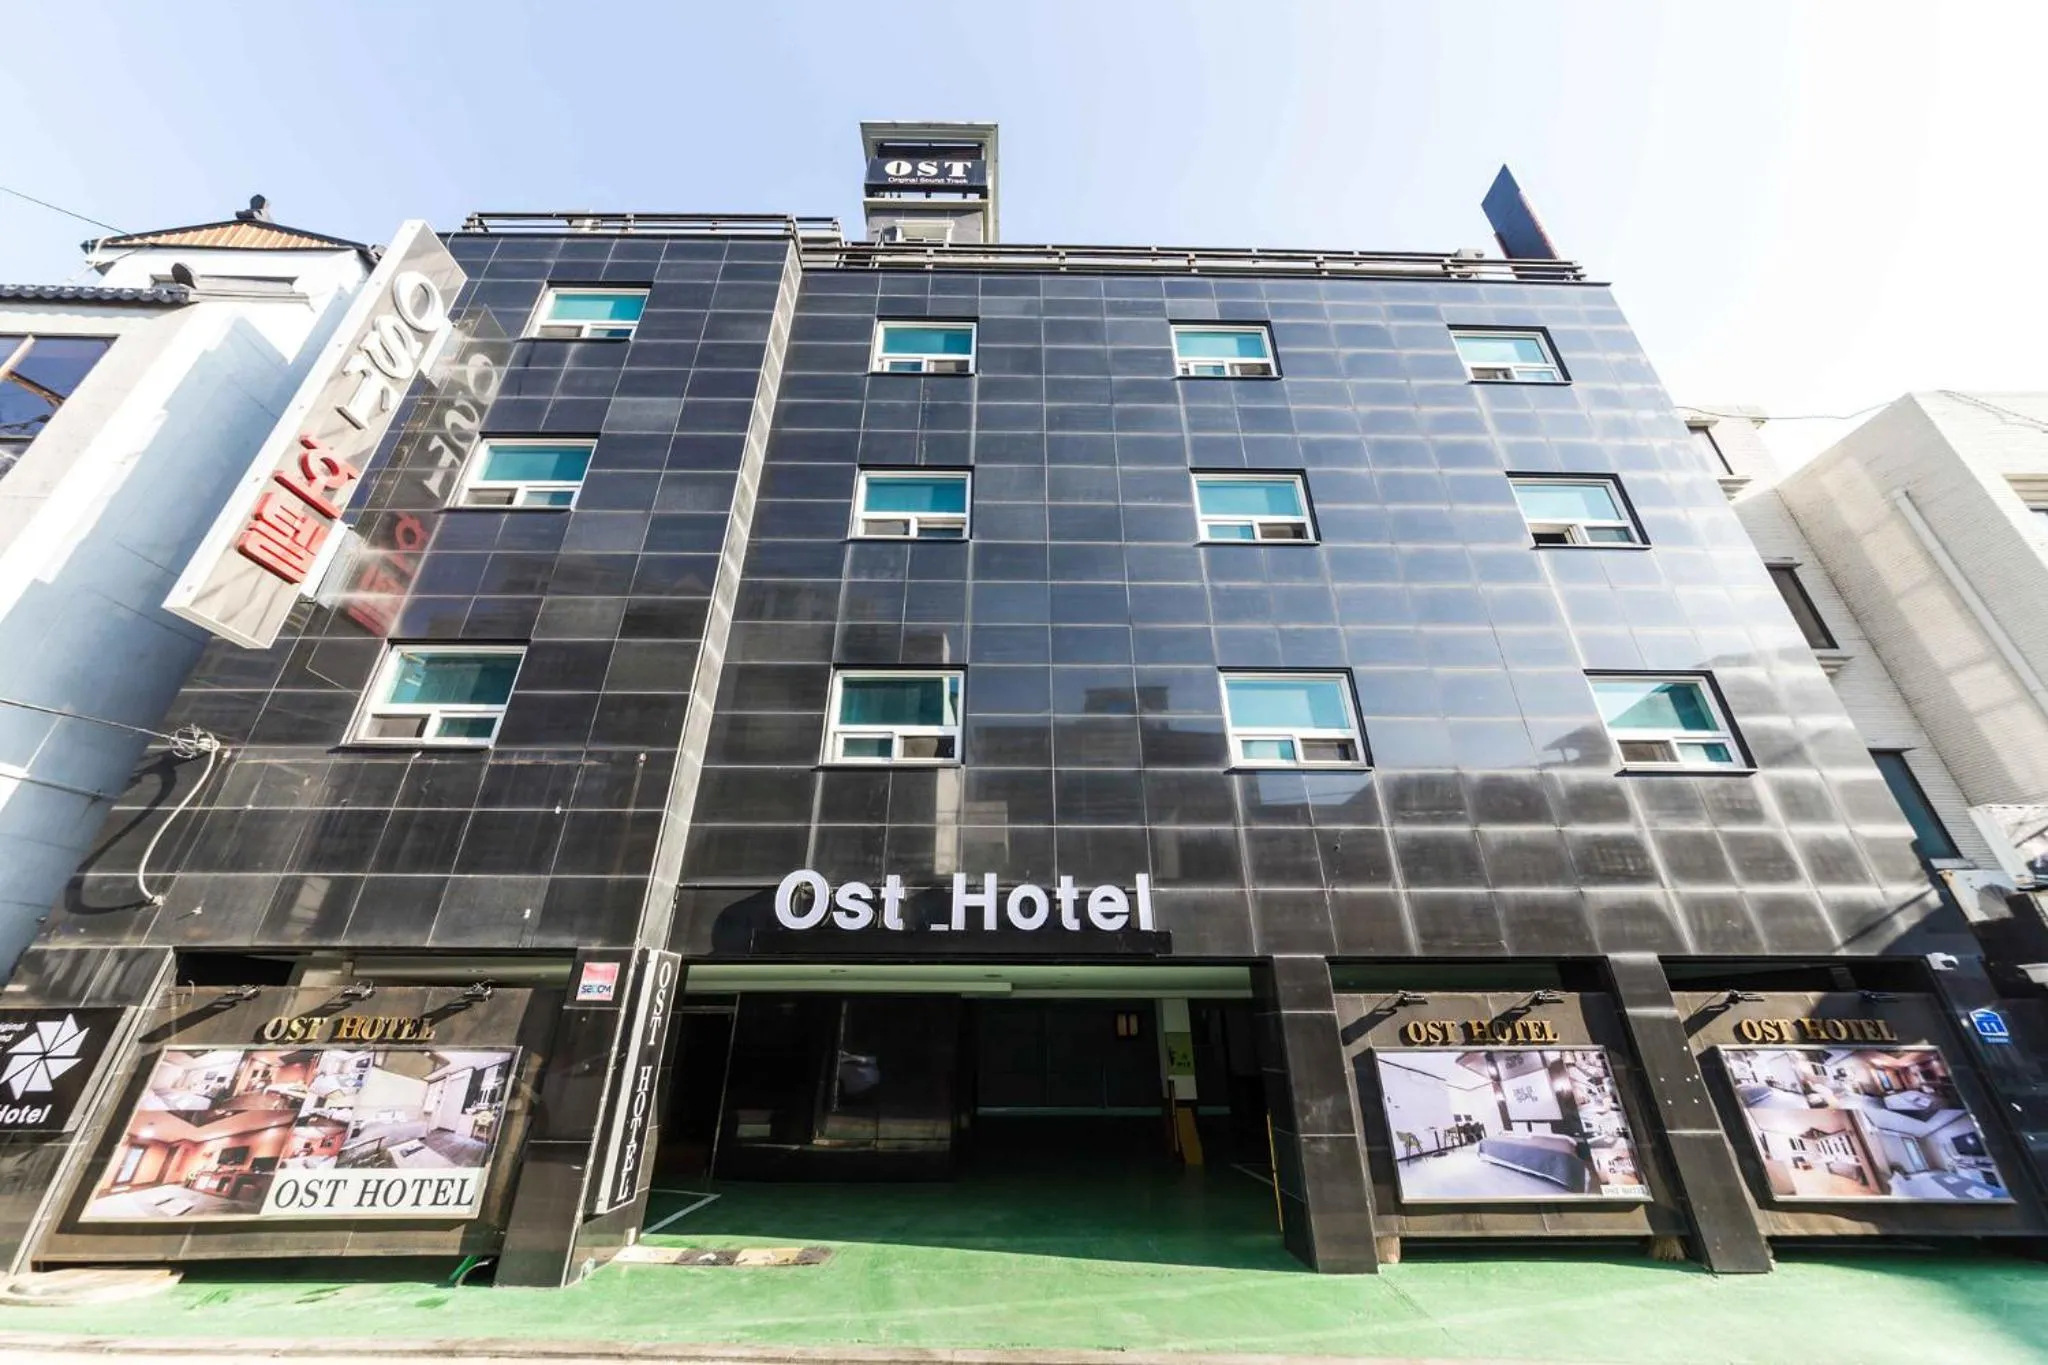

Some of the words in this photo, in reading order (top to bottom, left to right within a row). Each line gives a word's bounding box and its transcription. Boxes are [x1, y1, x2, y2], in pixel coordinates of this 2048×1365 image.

[885, 160, 972, 177] OST
[888, 177, 918, 185] Original
[335, 270, 443, 432] OST
[237, 433, 358, 585] 호텔
[775, 869, 905, 931] Ost
[648, 961, 671, 1045] OST
[264, 1016, 328, 1040] OST
[335, 1016, 436, 1040] HOTEL
[1407, 1020, 1457, 1043] OST
[1470, 1018, 1560, 1041] HOTEL
[1741, 1019, 1795, 1041] OST
[1800, 1018, 1898, 1041] HOTEL
[1982, 1022, 2000, 1033] 11
[616, 1066, 652, 1202] HOTEL
[274, 1179, 348, 1209] OST
[354, 1178, 475, 1208] HOTEL
